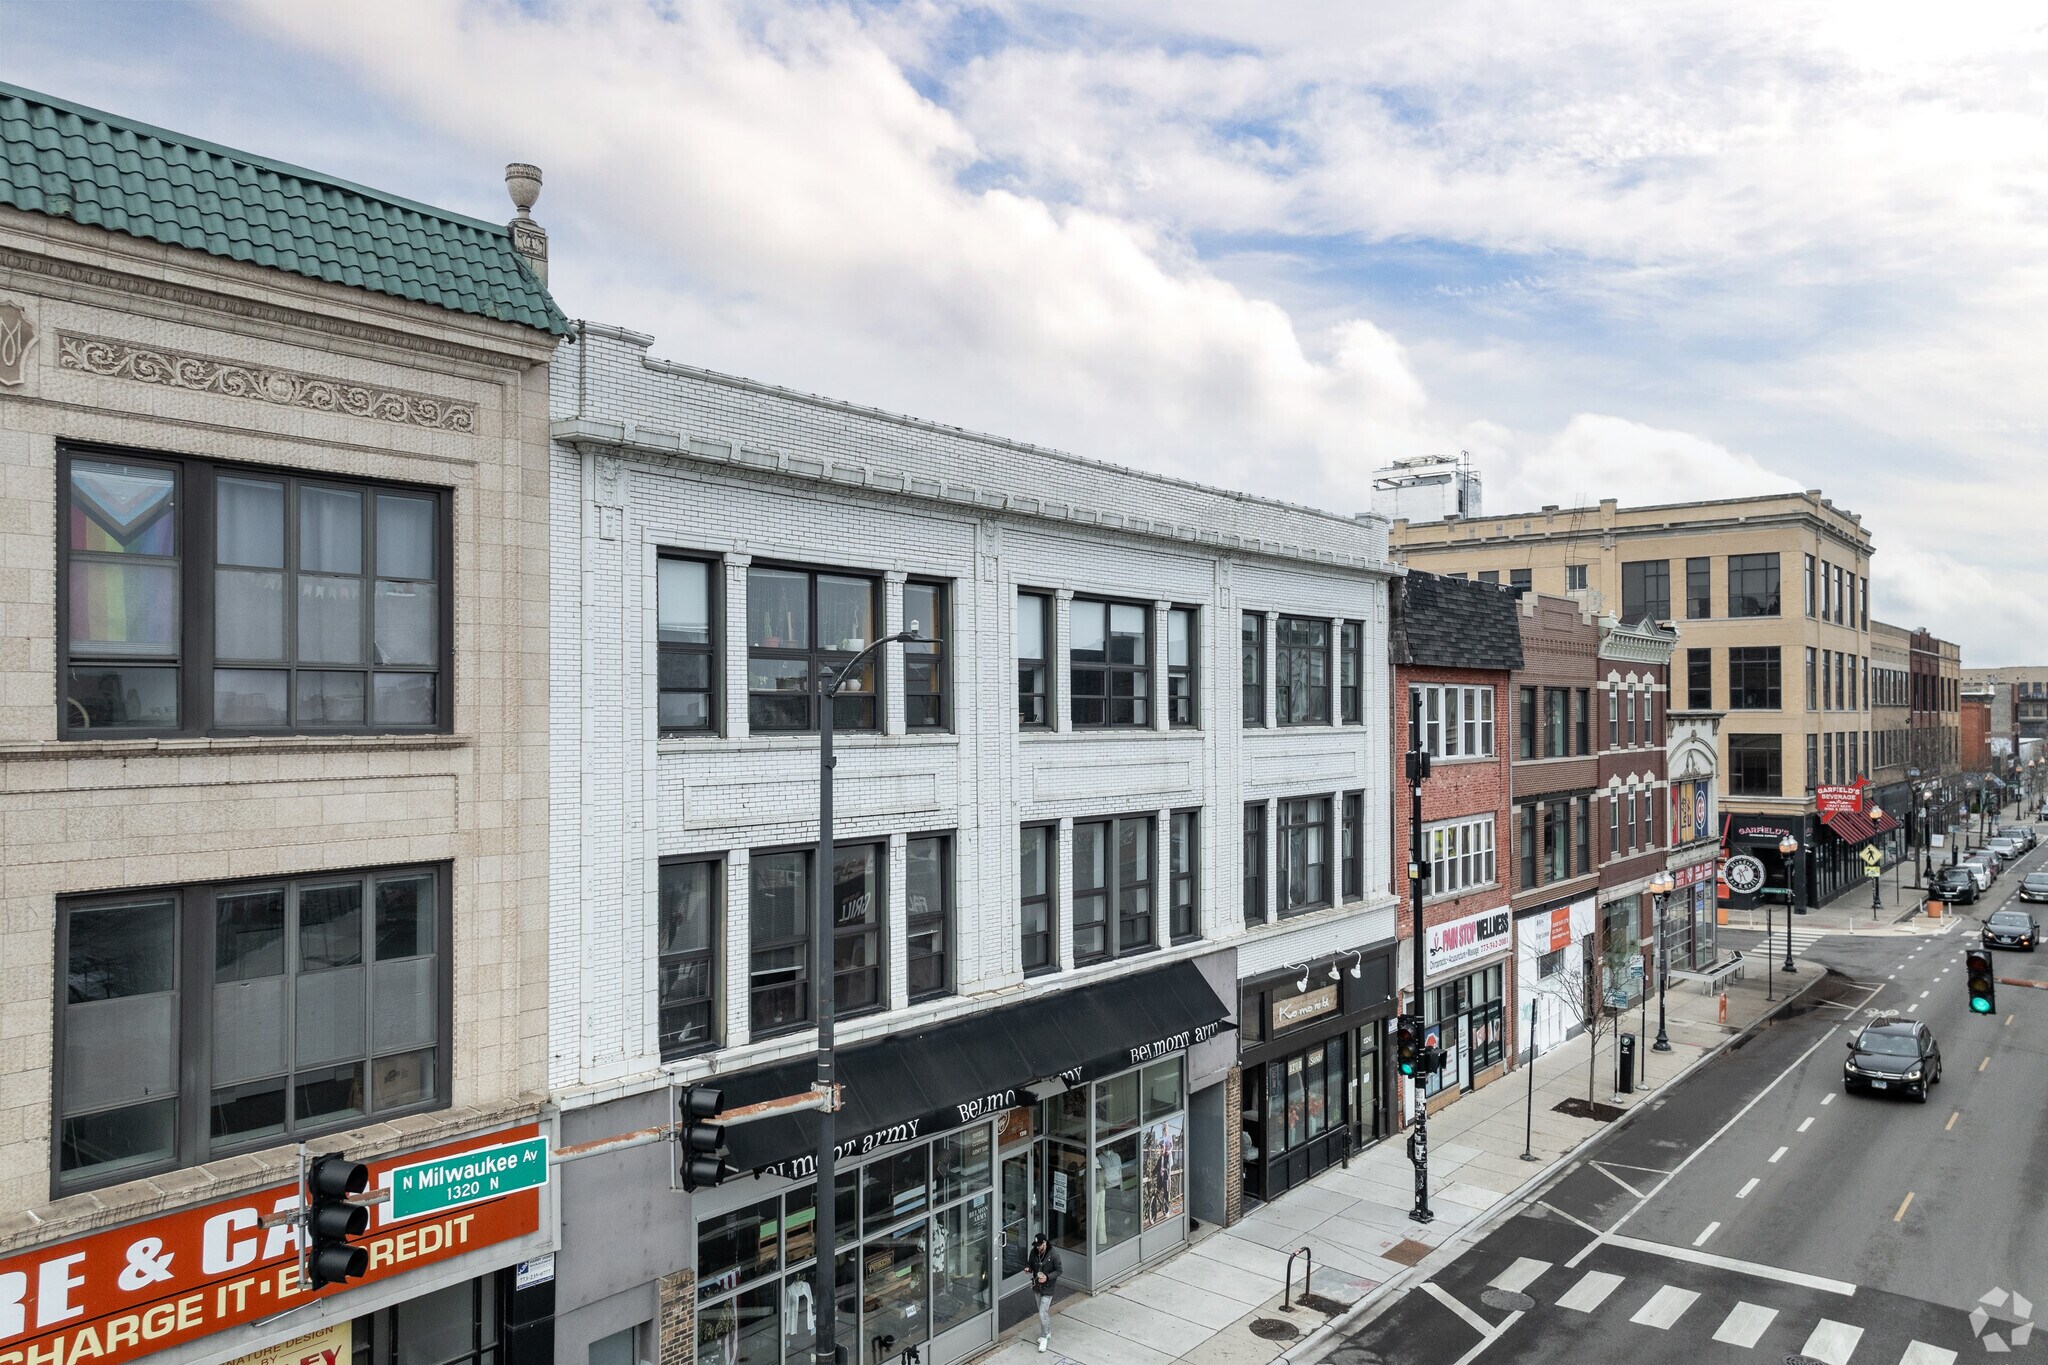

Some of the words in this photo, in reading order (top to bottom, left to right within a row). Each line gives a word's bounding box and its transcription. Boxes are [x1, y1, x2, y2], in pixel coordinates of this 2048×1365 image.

[1442, 925, 1458, 953] PAIN
[1458, 921, 1476, 947] STOP
[1476, 912, 1509, 942] WELLNESS
[403, 1175, 413, 1190] N
[418, 1154, 518, 1190] Milwaukee
[522, 1149, 538, 1163] Av
[447, 1181, 480, 1201] 1320
[489, 1176, 499, 1191] N
[117, 1237, 175, 1291] &
[0, 1294, 204, 1365] HARGE
[361, 1214, 475, 1271] REDIT
[286, 1326, 335, 1349] DESIGN
